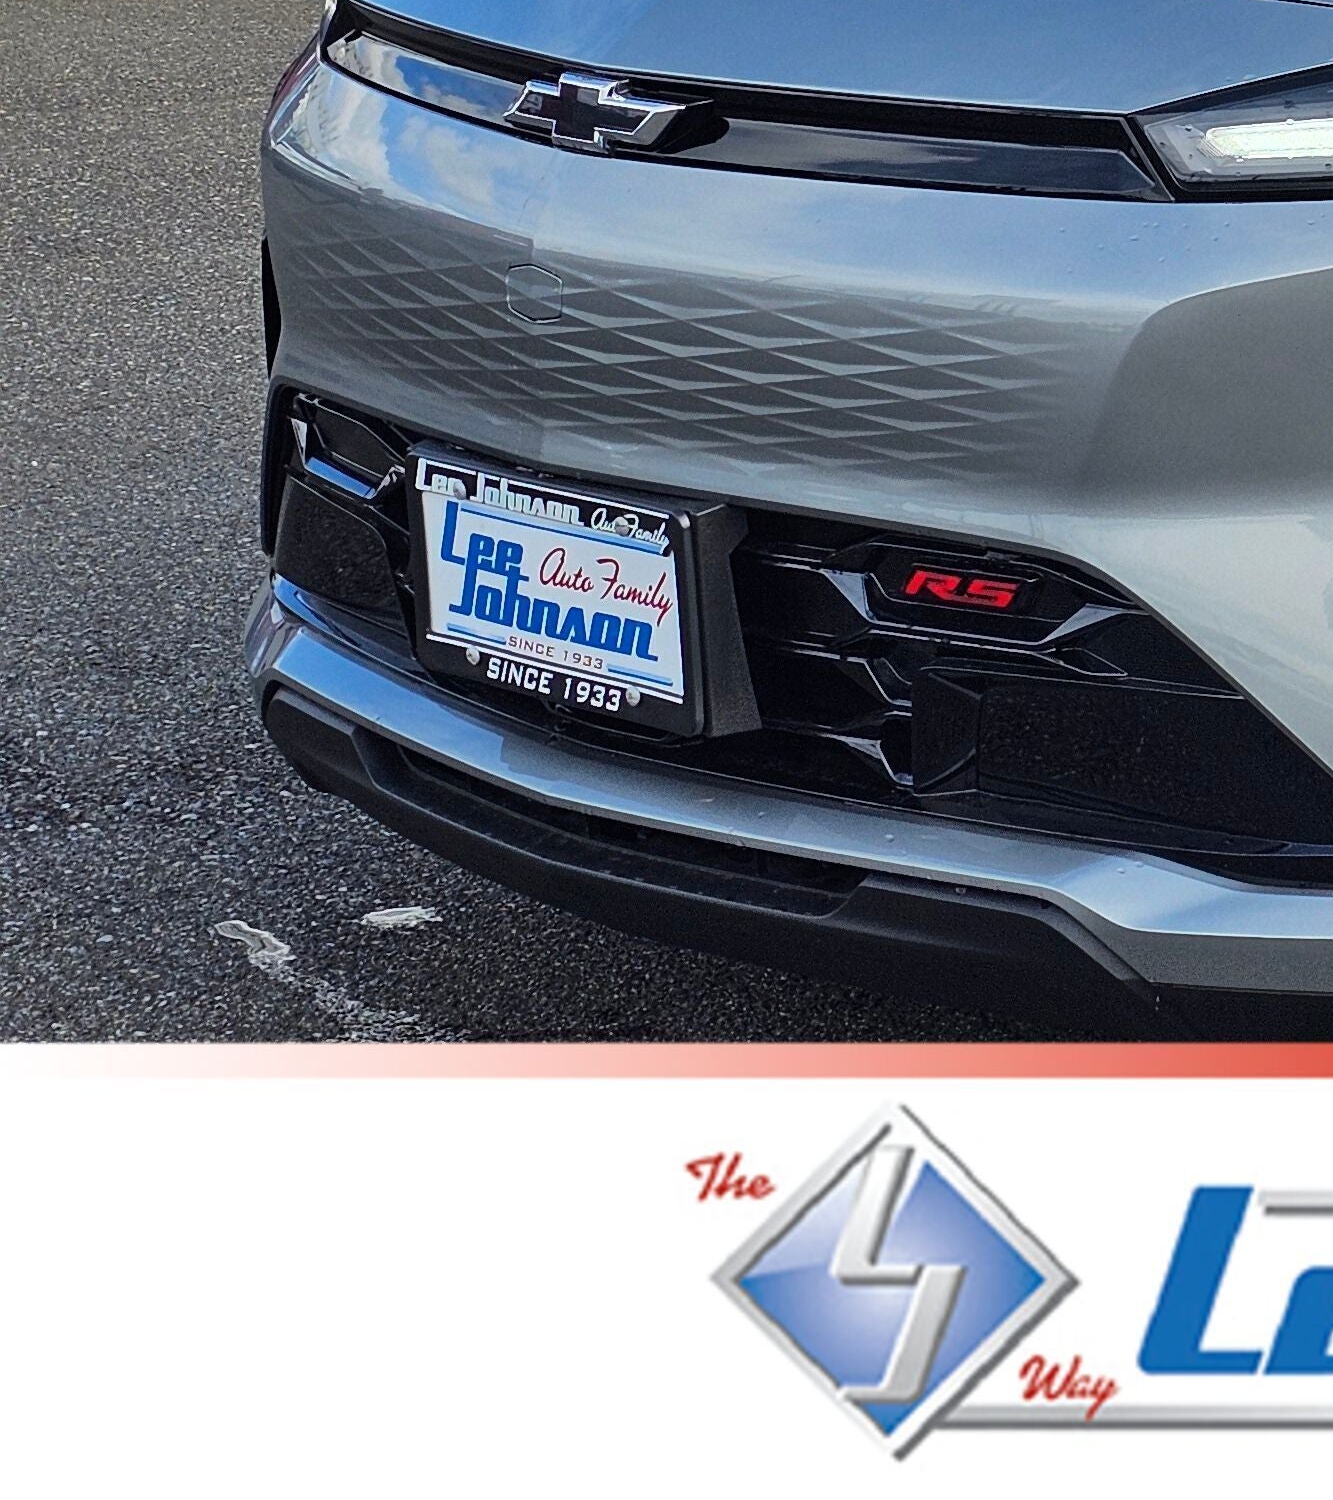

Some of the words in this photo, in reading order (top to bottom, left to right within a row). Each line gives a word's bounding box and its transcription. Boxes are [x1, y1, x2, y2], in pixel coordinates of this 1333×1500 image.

[469, 470, 585, 527] Johnson
[623, 512, 670, 555] Family
[440, 499, 530, 581] Lee
[539, 546, 595, 594] Auto
[595, 557, 674, 628] Family
[904, 569, 1020, 609] RS
[448, 564, 659, 662] Johnson
[486, 656, 554, 696] SINCE
[563, 676, 622, 713] 1933
[507, 635, 556, 658] SINCE
[563, 648, 605, 671] 1933
